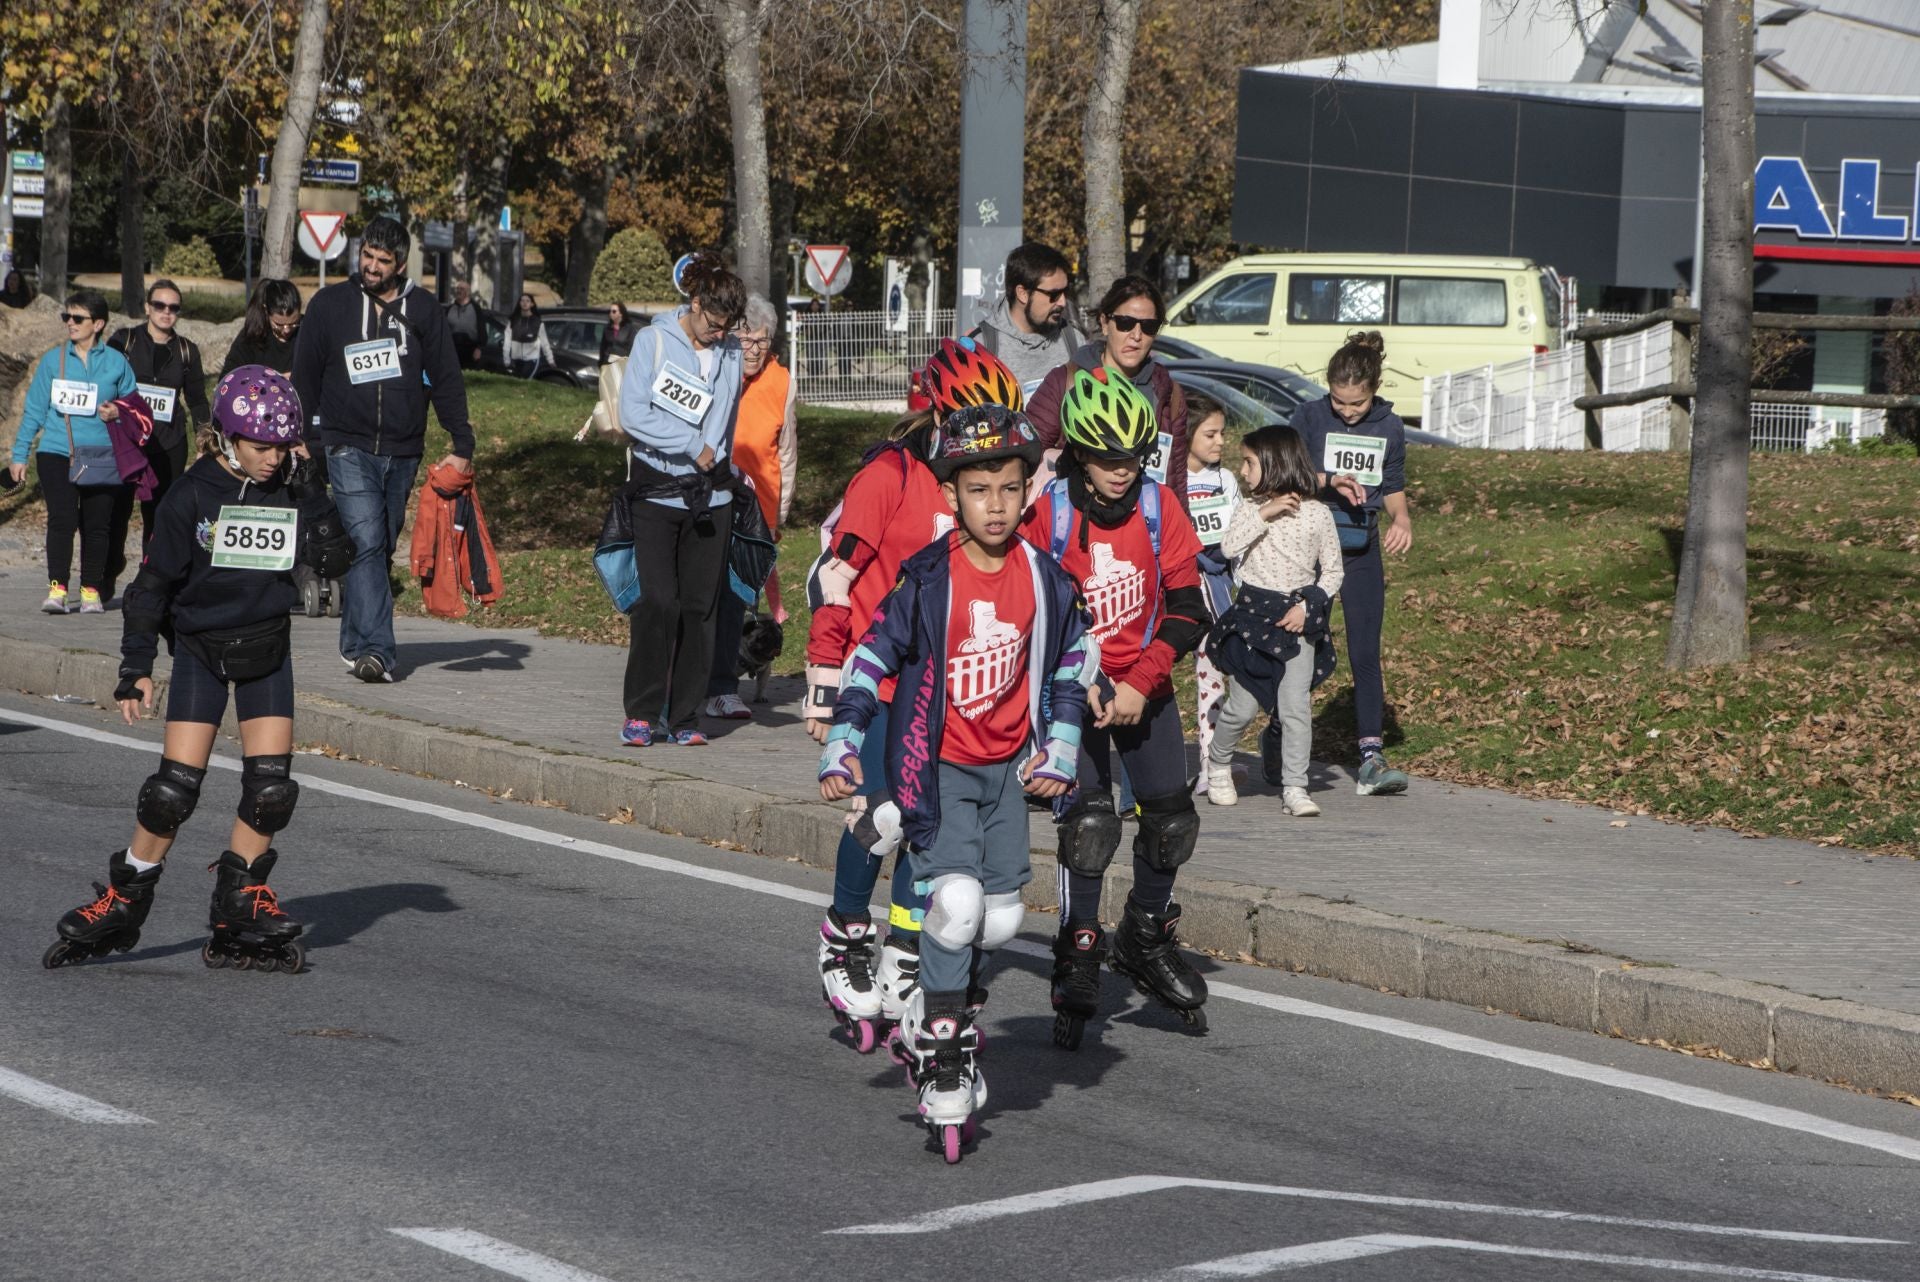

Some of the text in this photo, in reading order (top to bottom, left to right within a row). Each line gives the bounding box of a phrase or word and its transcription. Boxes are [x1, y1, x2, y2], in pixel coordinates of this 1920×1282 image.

[1753, 156, 1920, 242] AL
[353, 351, 391, 371] 6317
[659, 378, 702, 410] 2320
[1334, 450, 1375, 472] 1694
[224, 525, 286, 551] 5859
